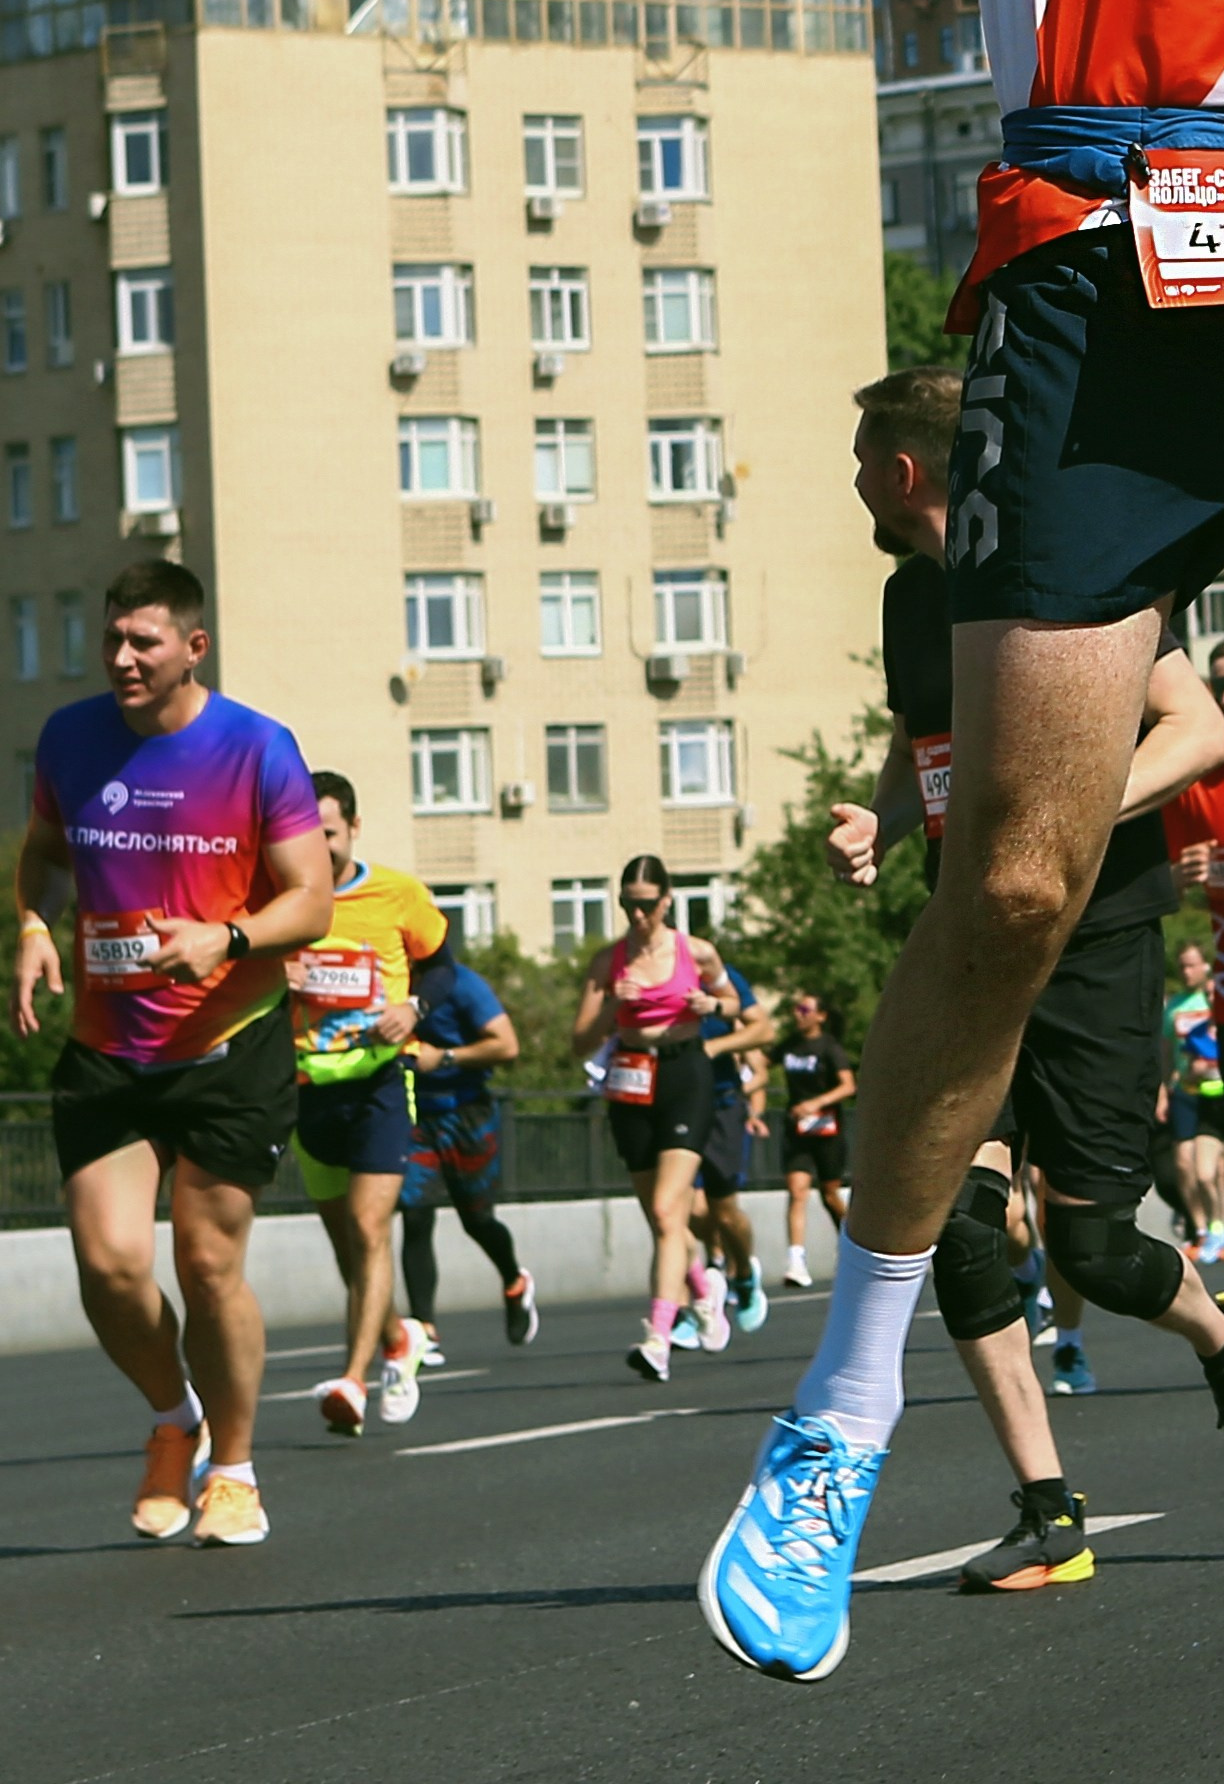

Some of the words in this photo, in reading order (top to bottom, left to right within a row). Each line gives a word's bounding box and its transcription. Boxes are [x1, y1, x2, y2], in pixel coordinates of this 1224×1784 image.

[1149, 167, 1202, 187] ЗАБЕГ
[77, 827, 238, 855] ПРИСЛОНЯТЬСЯ
[91, 940, 145, 961] 45819
[309, 969, 359, 984] 47984
